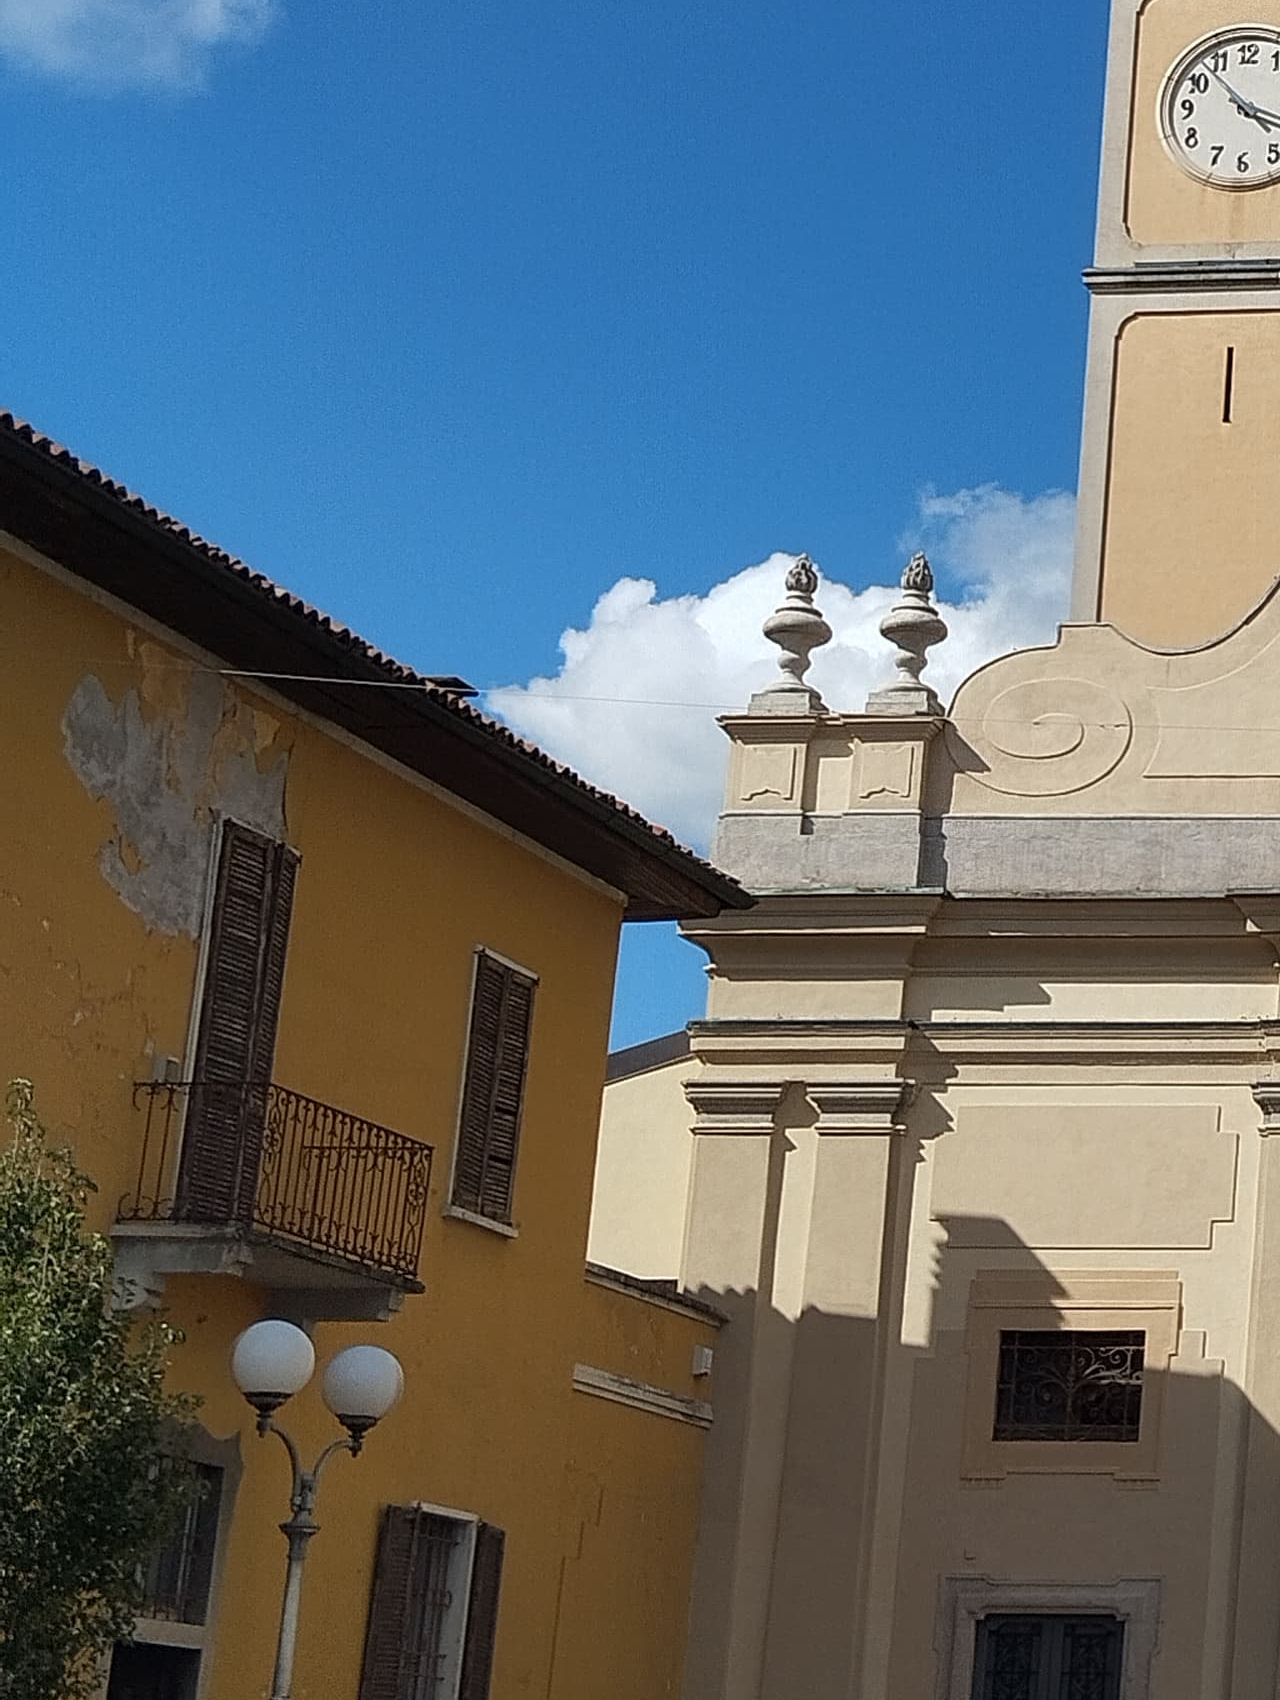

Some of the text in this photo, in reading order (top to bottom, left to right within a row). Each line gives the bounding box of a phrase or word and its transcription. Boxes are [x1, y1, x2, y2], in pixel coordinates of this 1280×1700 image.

[1210, 50, 1228, 73] 11
[1236, 43, 1260, 66] 12
[1271, 51, 1280, 72] 1
[1187, 72, 1209, 94] 10
[1181, 100, 1194, 120] 9
[1184, 127, 1199, 149] 8
[1209, 145, 1225, 167] 7
[1236, 151, 1250, 173] 6
[1266, 143, 1280, 165] 5
